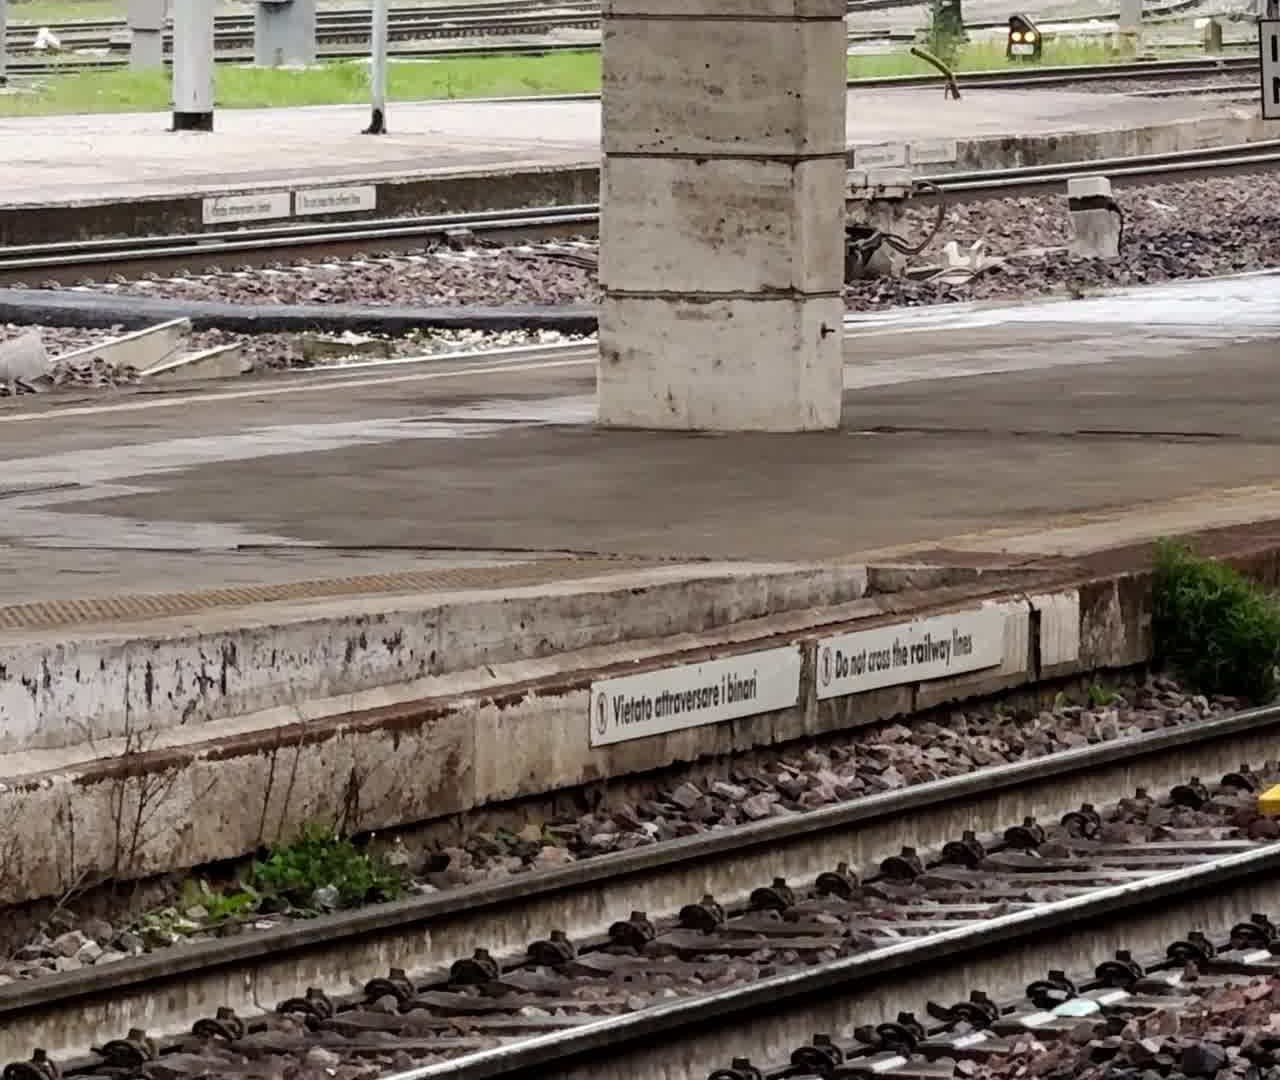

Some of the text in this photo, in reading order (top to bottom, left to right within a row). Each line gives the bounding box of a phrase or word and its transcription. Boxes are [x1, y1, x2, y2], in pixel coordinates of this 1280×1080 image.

[835, 627, 973, 679] Do not cross the railway lines
[612, 669, 758, 727] Vietato attraversare i binari
